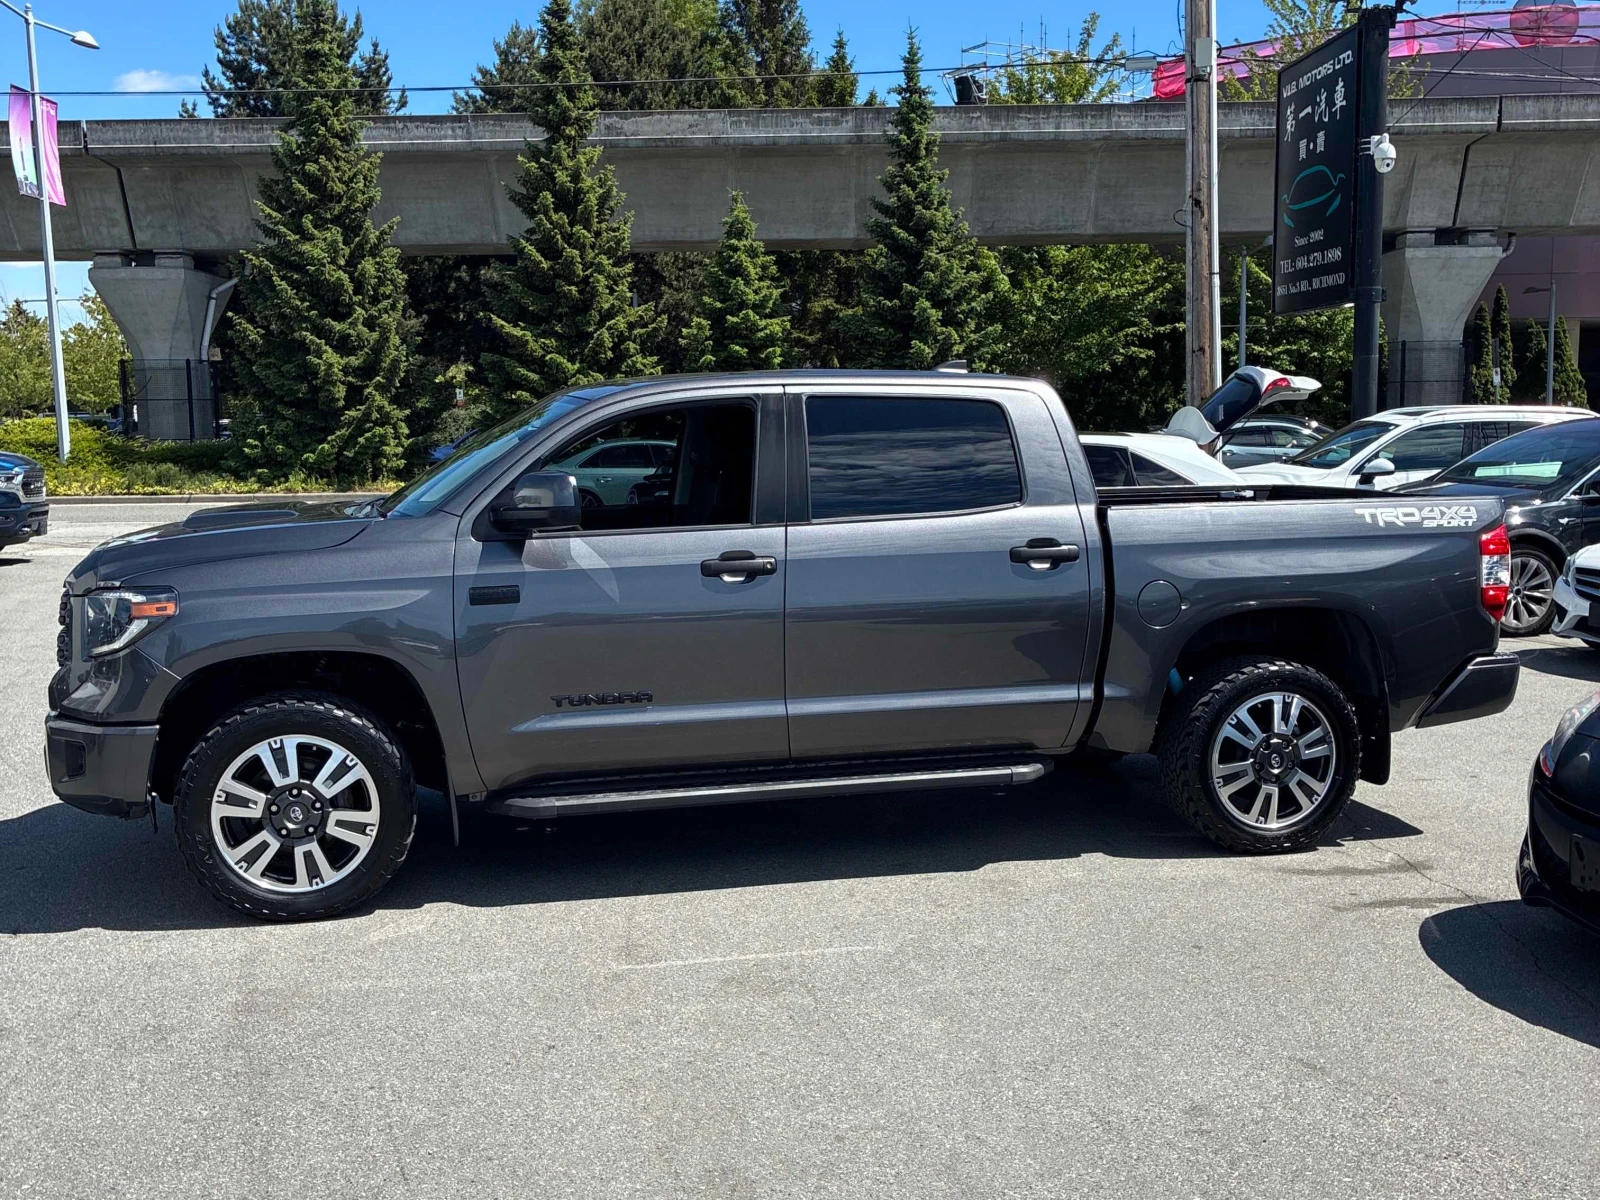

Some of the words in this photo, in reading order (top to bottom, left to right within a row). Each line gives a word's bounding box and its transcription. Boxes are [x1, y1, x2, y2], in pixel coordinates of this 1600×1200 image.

[1298, 60, 1334, 90] MOTORS
[1335, 50, 1353, 70] LTD.
[1284, 77, 1346, 142] 第一汽車
[1294, 235, 1309, 248] Since
[1309, 228, 1324, 242] 2002
[1280, 259, 1295, 274] TEL:
[1295, 247, 1342, 270] 604.279.1898
[1312, 272, 1346, 290] RICHMOND
[1355, 507, 1421, 527] TRD
[1421, 506, 1478, 520] 4X4
[1422, 519, 1477, 527] SPORT
[550, 690, 653, 707] TUNDRA
